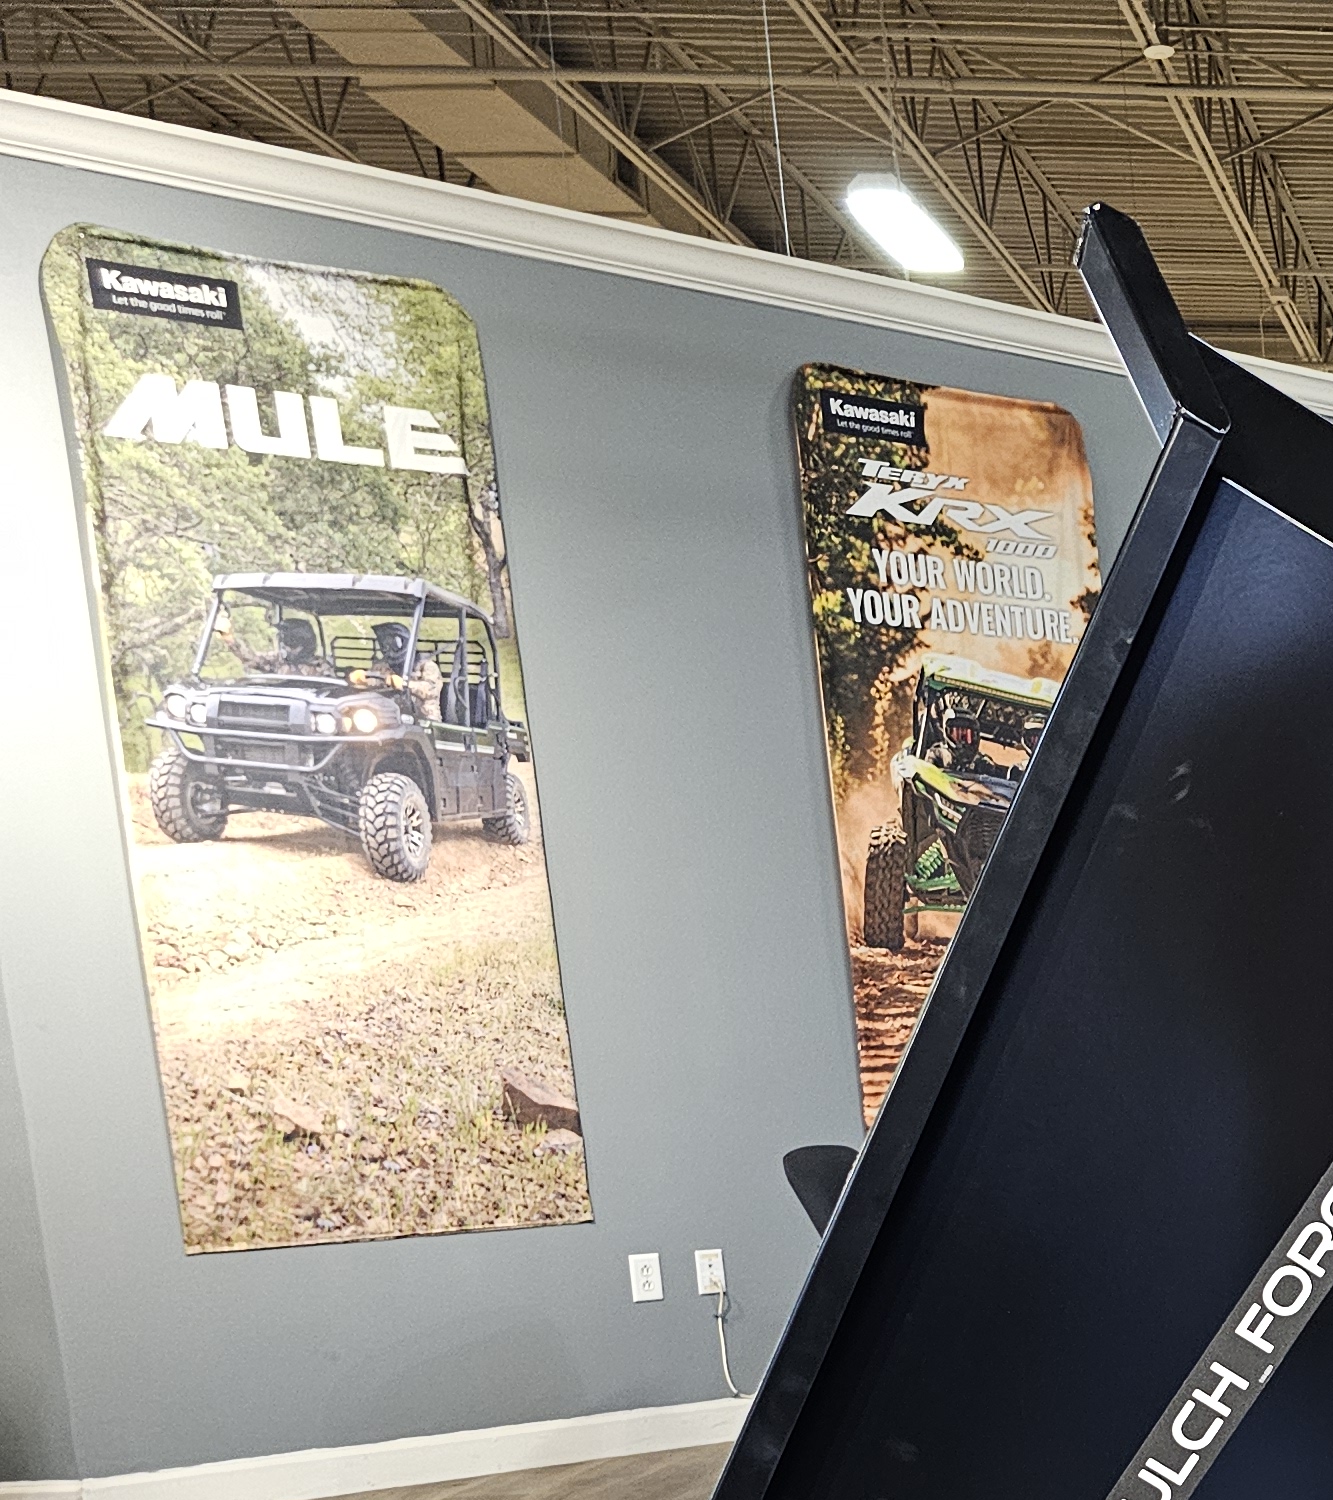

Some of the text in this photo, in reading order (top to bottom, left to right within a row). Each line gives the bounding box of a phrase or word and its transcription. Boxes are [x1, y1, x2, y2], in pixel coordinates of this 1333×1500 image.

[99, 267, 228, 308] Kawasaki
[112, 294, 224, 321] Let the good times roll
[103, 372, 471, 476] MULE
[829, 397, 916, 428] Kawasaki
[836, 418, 913, 439] Let the good times roll
[845, 480, 1055, 541] KRX
[985, 537, 1059, 560] 1000
[871, 547, 1052, 600] YOUR WORLD.
[846, 587, 1080, 645] YOUR ADVENTURE.
